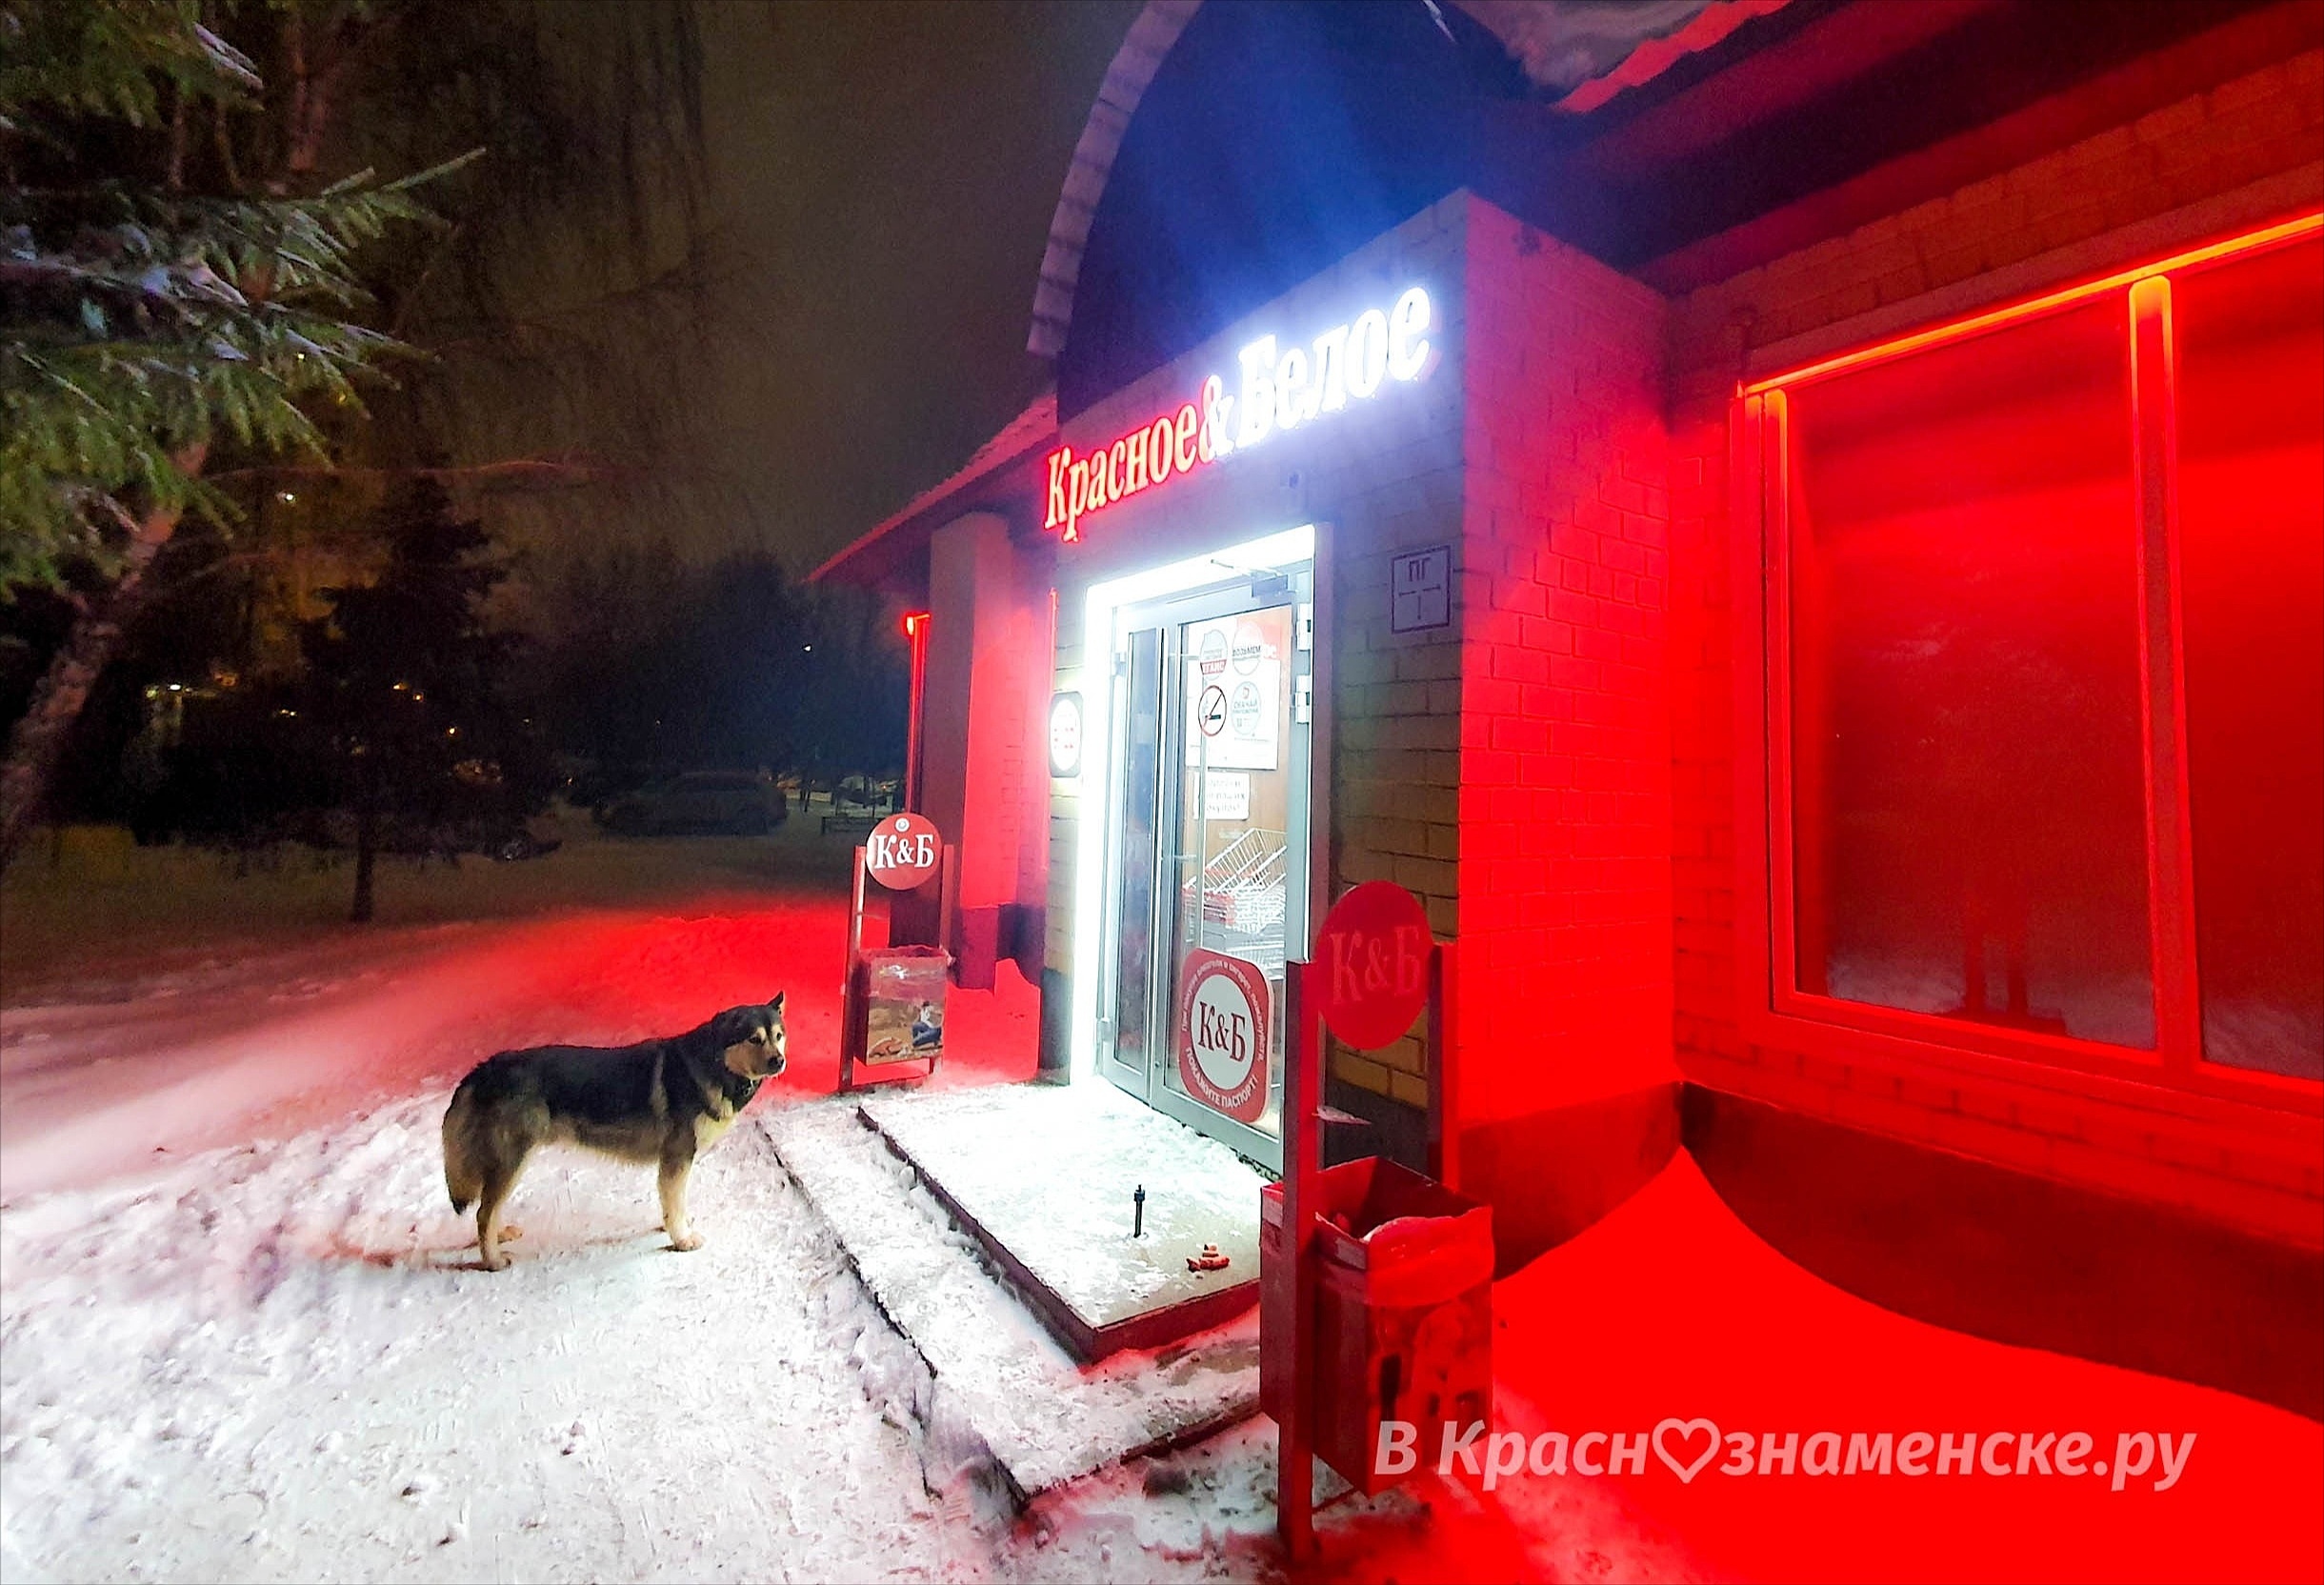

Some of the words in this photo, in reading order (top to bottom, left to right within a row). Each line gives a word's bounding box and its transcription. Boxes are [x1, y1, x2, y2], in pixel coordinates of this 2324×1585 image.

[873, 833, 934, 869] К&Б
[1329, 925, 1420, 1005] К&Б
[1197, 1000, 1246, 1063] К&Б
